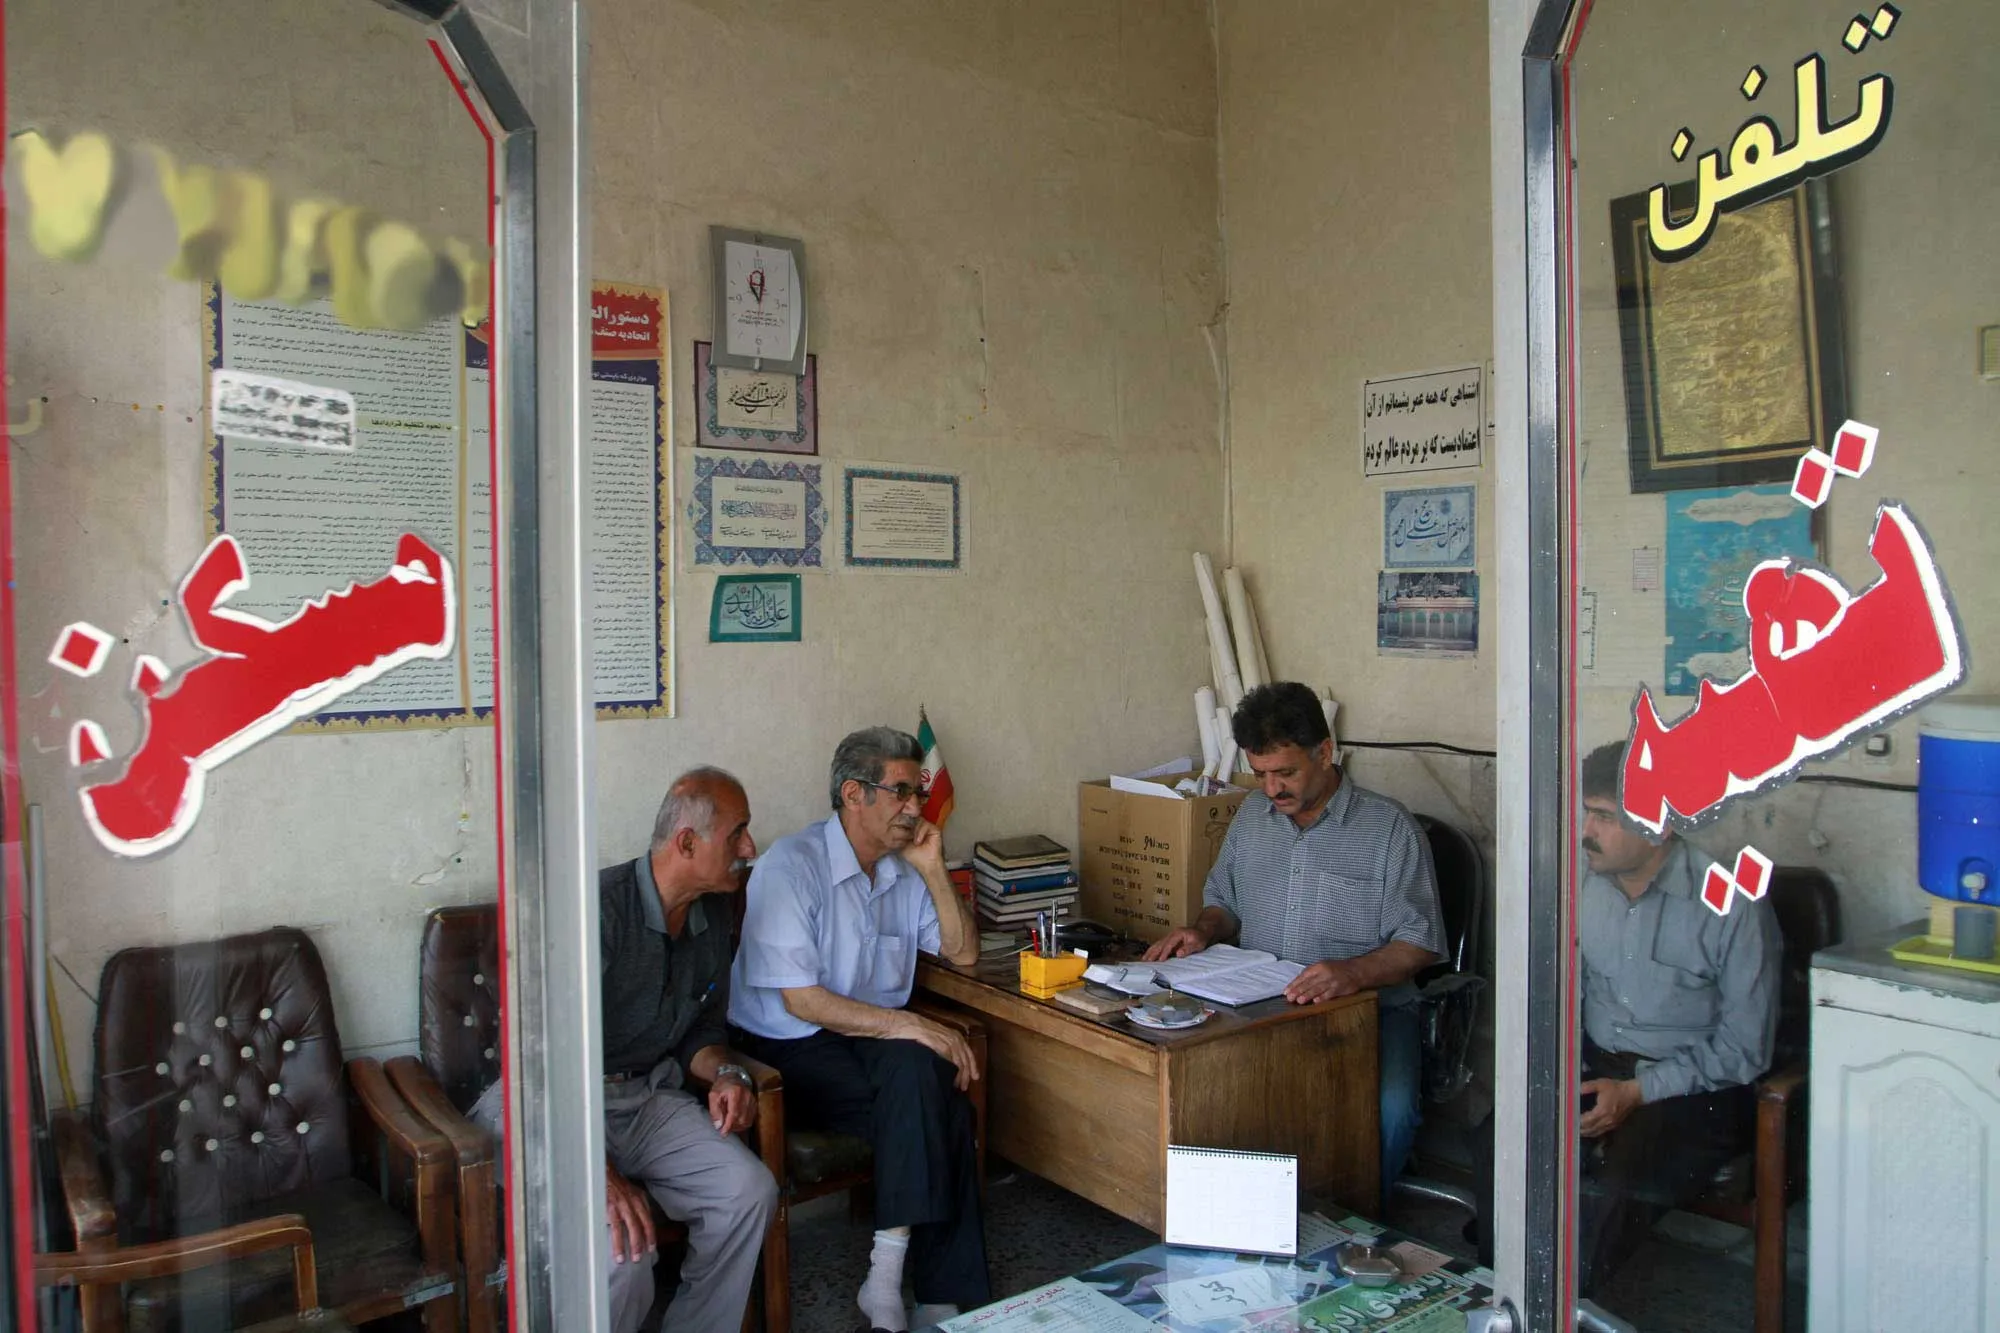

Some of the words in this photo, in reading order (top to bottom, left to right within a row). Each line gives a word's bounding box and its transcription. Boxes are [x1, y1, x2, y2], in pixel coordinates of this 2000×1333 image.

[1648, 3, 1900, 263] تلفن
[1367, 393, 1376, 418] آن
[1378, 394, 1384, 417] از
[1426, 391, 1438, 404] همه
[1440, 387, 1448, 402] که
[1450, 382, 1480, 407] اشتباهی
[1365, 440, 1382, 467] کردم
[1430, 434, 1438, 454] که
[1622, 418, 1968, 916] تهیه
[48, 531, 456, 858] مسکن
